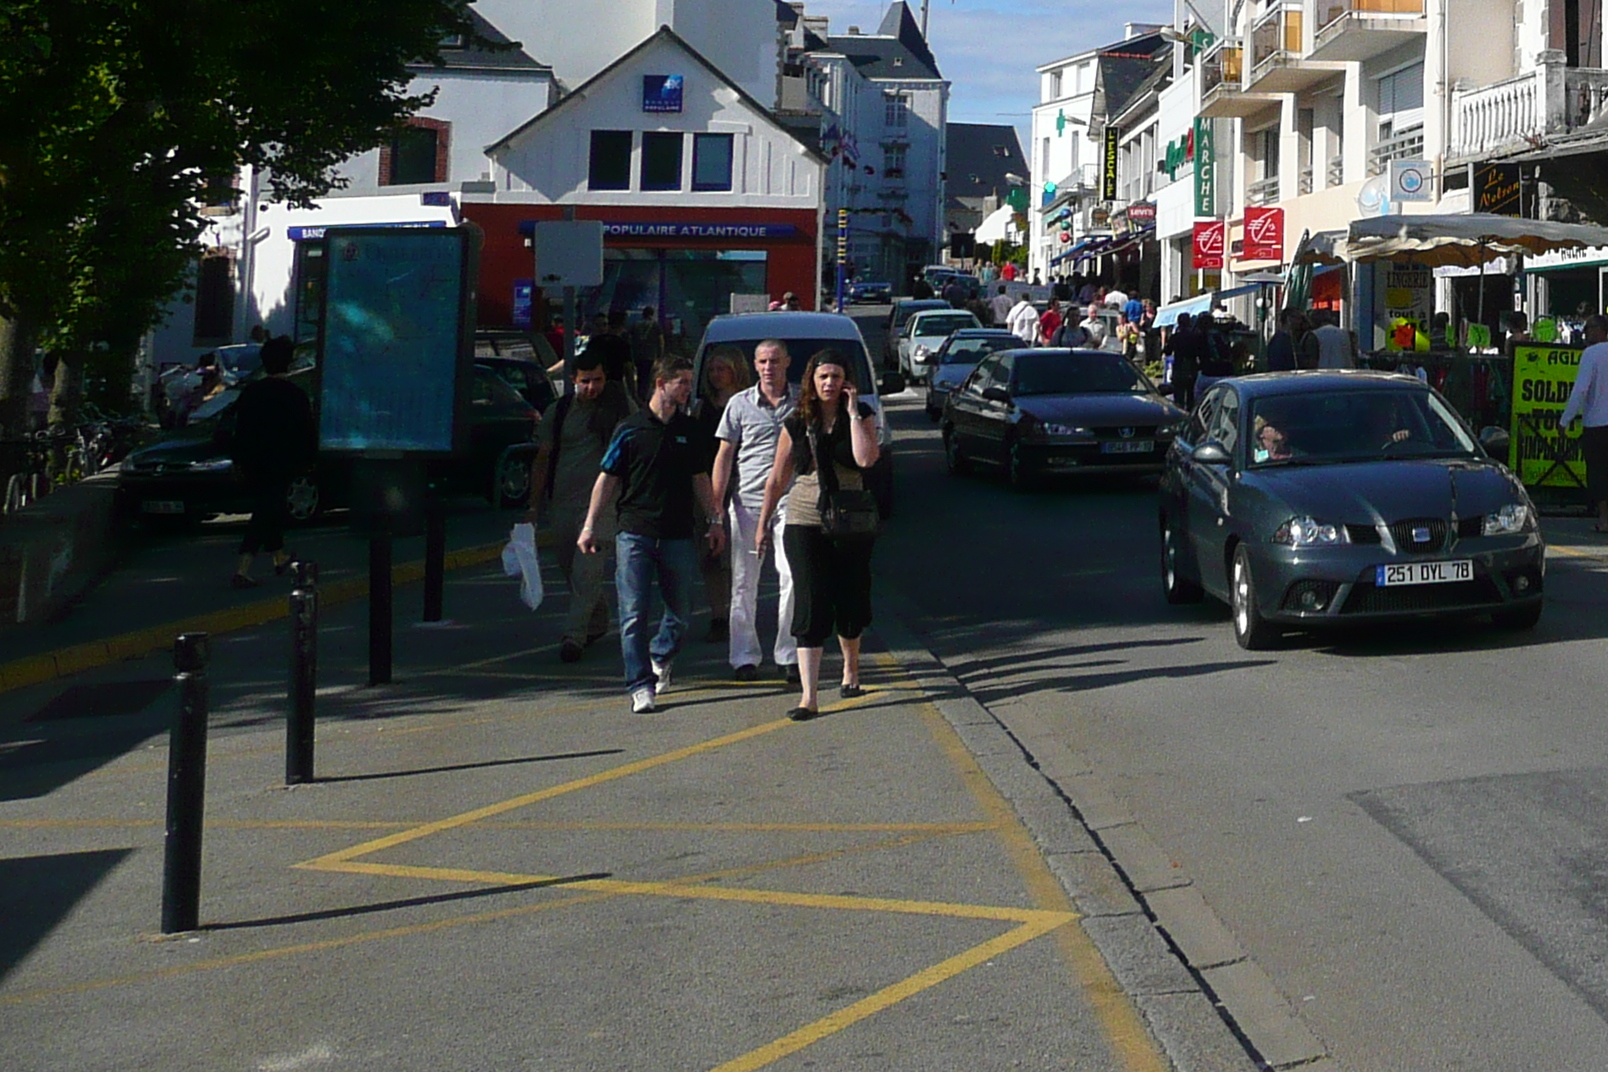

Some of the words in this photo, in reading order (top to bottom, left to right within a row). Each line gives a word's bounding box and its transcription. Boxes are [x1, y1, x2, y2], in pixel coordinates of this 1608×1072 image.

[602, 225, 677, 235] POPULAIRE
[680, 225, 767, 237] ATLANTIQUE
[1386, 271, 1429, 288] LINGERIE
[1387, 565, 1414, 583] 251
[1420, 563, 1447, 581] DYL
[1451, 562, 1469, 579] 78
